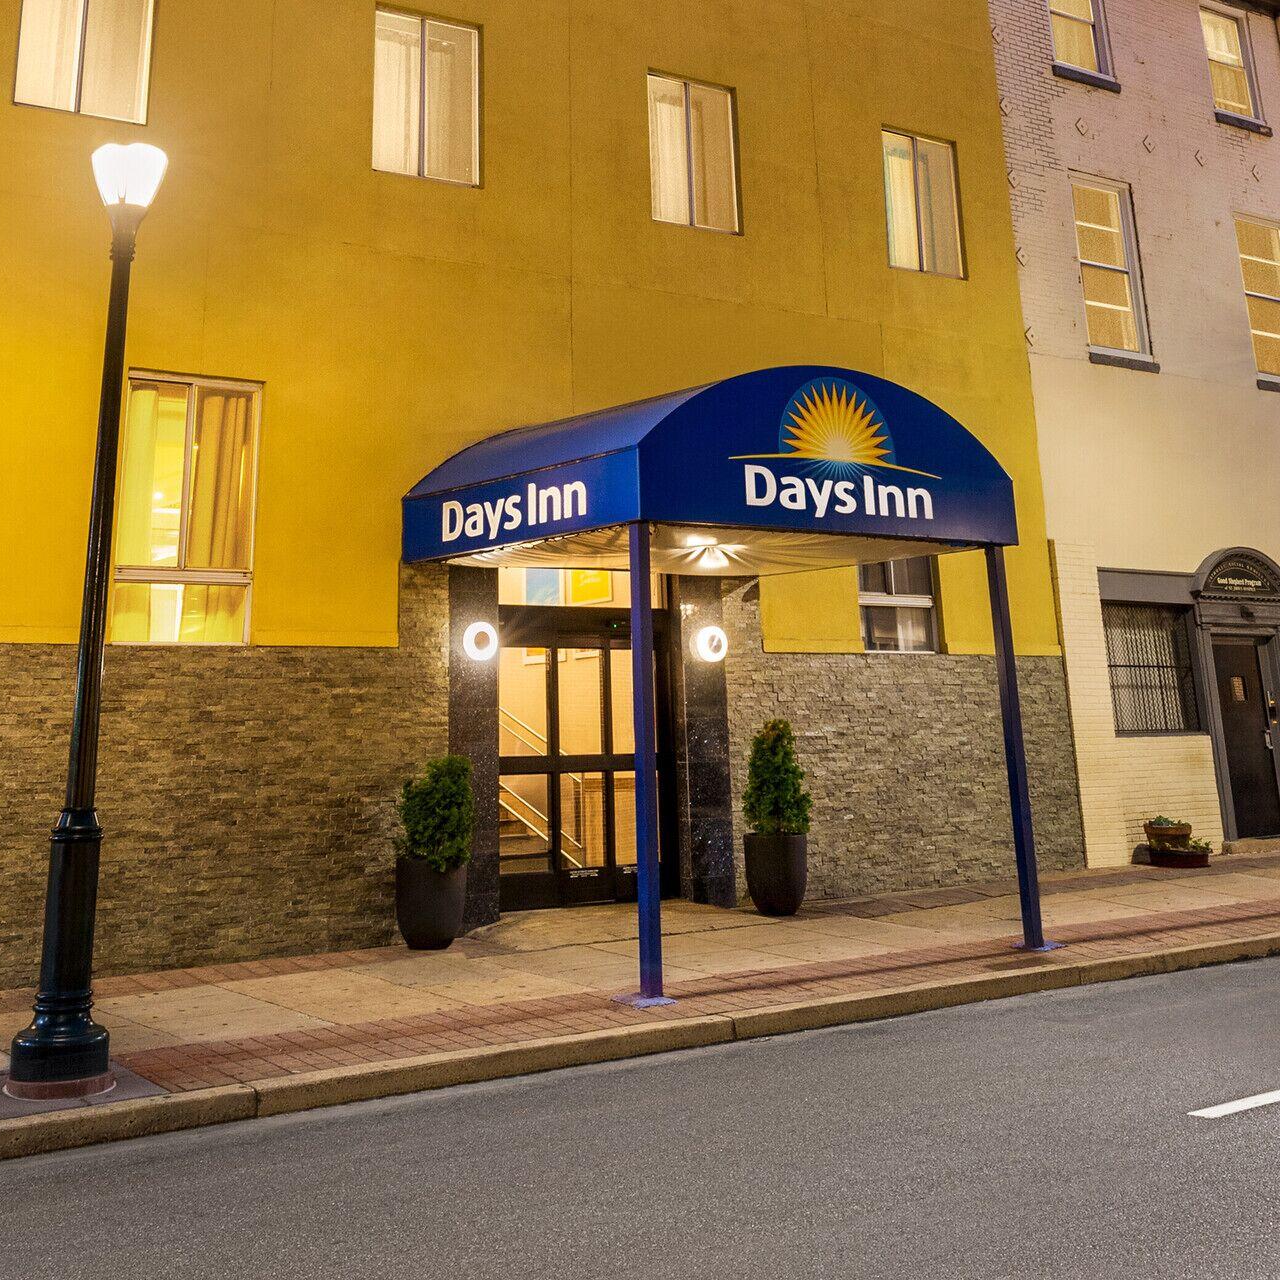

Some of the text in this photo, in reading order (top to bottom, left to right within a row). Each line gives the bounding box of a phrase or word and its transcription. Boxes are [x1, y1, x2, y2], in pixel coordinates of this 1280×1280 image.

[441, 480, 587, 543] Days Inn
[744, 464, 934, 520] Days Inn
